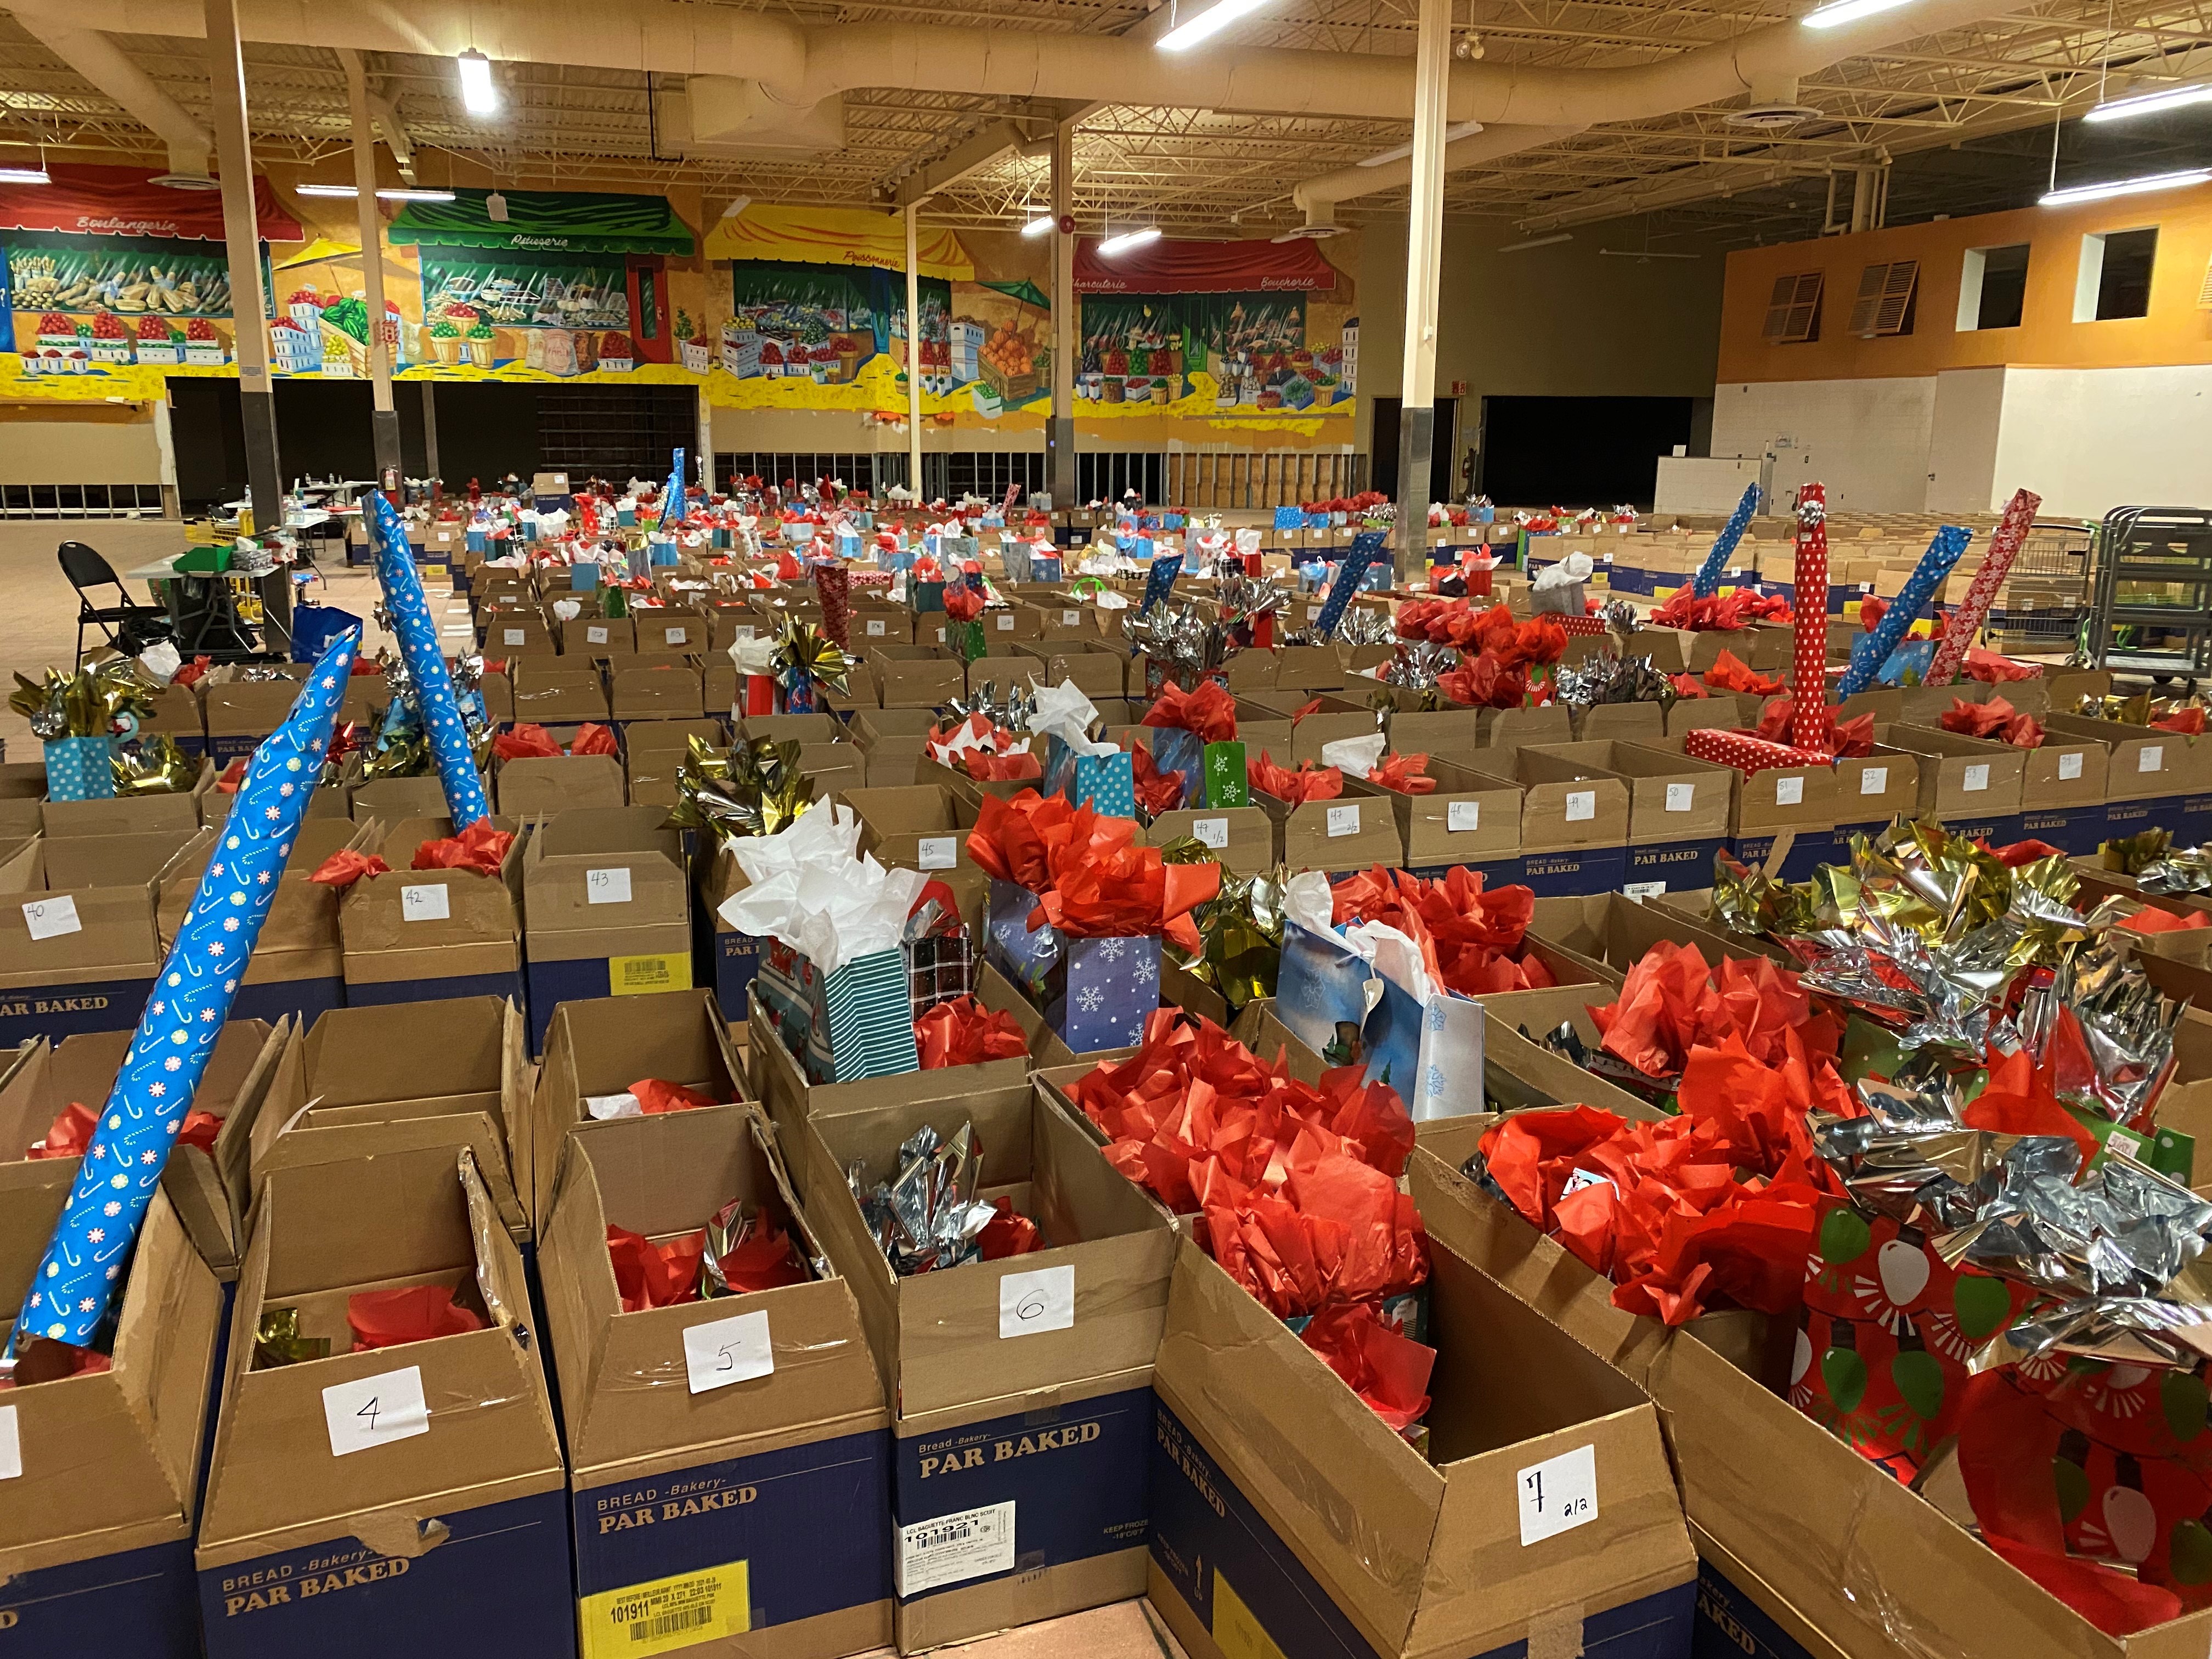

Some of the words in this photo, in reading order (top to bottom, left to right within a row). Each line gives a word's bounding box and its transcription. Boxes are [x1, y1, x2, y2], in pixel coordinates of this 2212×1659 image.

[77, 217, 179, 233] Boulangerie
[843, 251, 900, 268] Poissonnerie
[1261, 276, 1316, 286] Boucherie
[1864, 770, 1875, 780] 52
[1669, 787, 1678, 797] 50
[1451, 804, 1461, 816] 48
[1568, 797, 1578, 808] 49
[1330, 809, 1342, 820] 47
[1197, 822, 1209, 834] 47
[1347, 822, 1358, 833] 2/2
[1960, 828, 1993, 837] BAKED
[1214, 831, 1224, 844] 1/2
[1832, 836, 1844, 844] AR
[922, 843, 934, 856] 45
[1634, 854, 1656, 865] PAR
[1660, 851, 1698, 862] BAKED
[1527, 866, 1544, 875] PAR
[1547, 864, 1579, 874] BAKED
[591, 871, 608, 887] 43
[406, 890, 423, 905] 42
[27, 904, 44, 920] 40
[726, 946, 752, 957] PAR
[0, 1003, 30, 1016] AR
[35, 997, 108, 1014] BAKED
[1017, 1289, 1044, 1321] 6
[716, 1341, 741, 1371] 5
[357, 1396, 380, 1430] 4
[1158, 1408, 1182, 1446] BREAD
[919, 1438, 952, 1454] Bread
[919, 1448, 985, 1479] PAR
[994, 1421, 1101, 1462] BAKED
[1157, 1426, 1180, 1465] PAR
[1182, 1458, 1224, 1518] BAKED
[597, 1489, 657, 1511] BREAD
[664, 1479, 726, 1497] -Bakery-
[1526, 1471, 1544, 1513] 7
[599, 1509, 655, 1534] PAR
[663, 1487, 757, 1521] BAKED
[904, 1519, 978, 1543] 101921
[918, 1520, 945, 1531] BAGUETTE
[946, 1516, 964, 1524] FRANC
[1103, 1525, 1124, 1534] KEEP
[1125, 1519, 1149, 1529] FROZE
[223, 1565, 292, 1591] BREAD
[225, 1584, 291, 1616] PAR
[300, 1558, 410, 1598] BAKED
[610, 1600, 649, 1624] 101911
[1697, 1593, 1756, 1655] AKED
